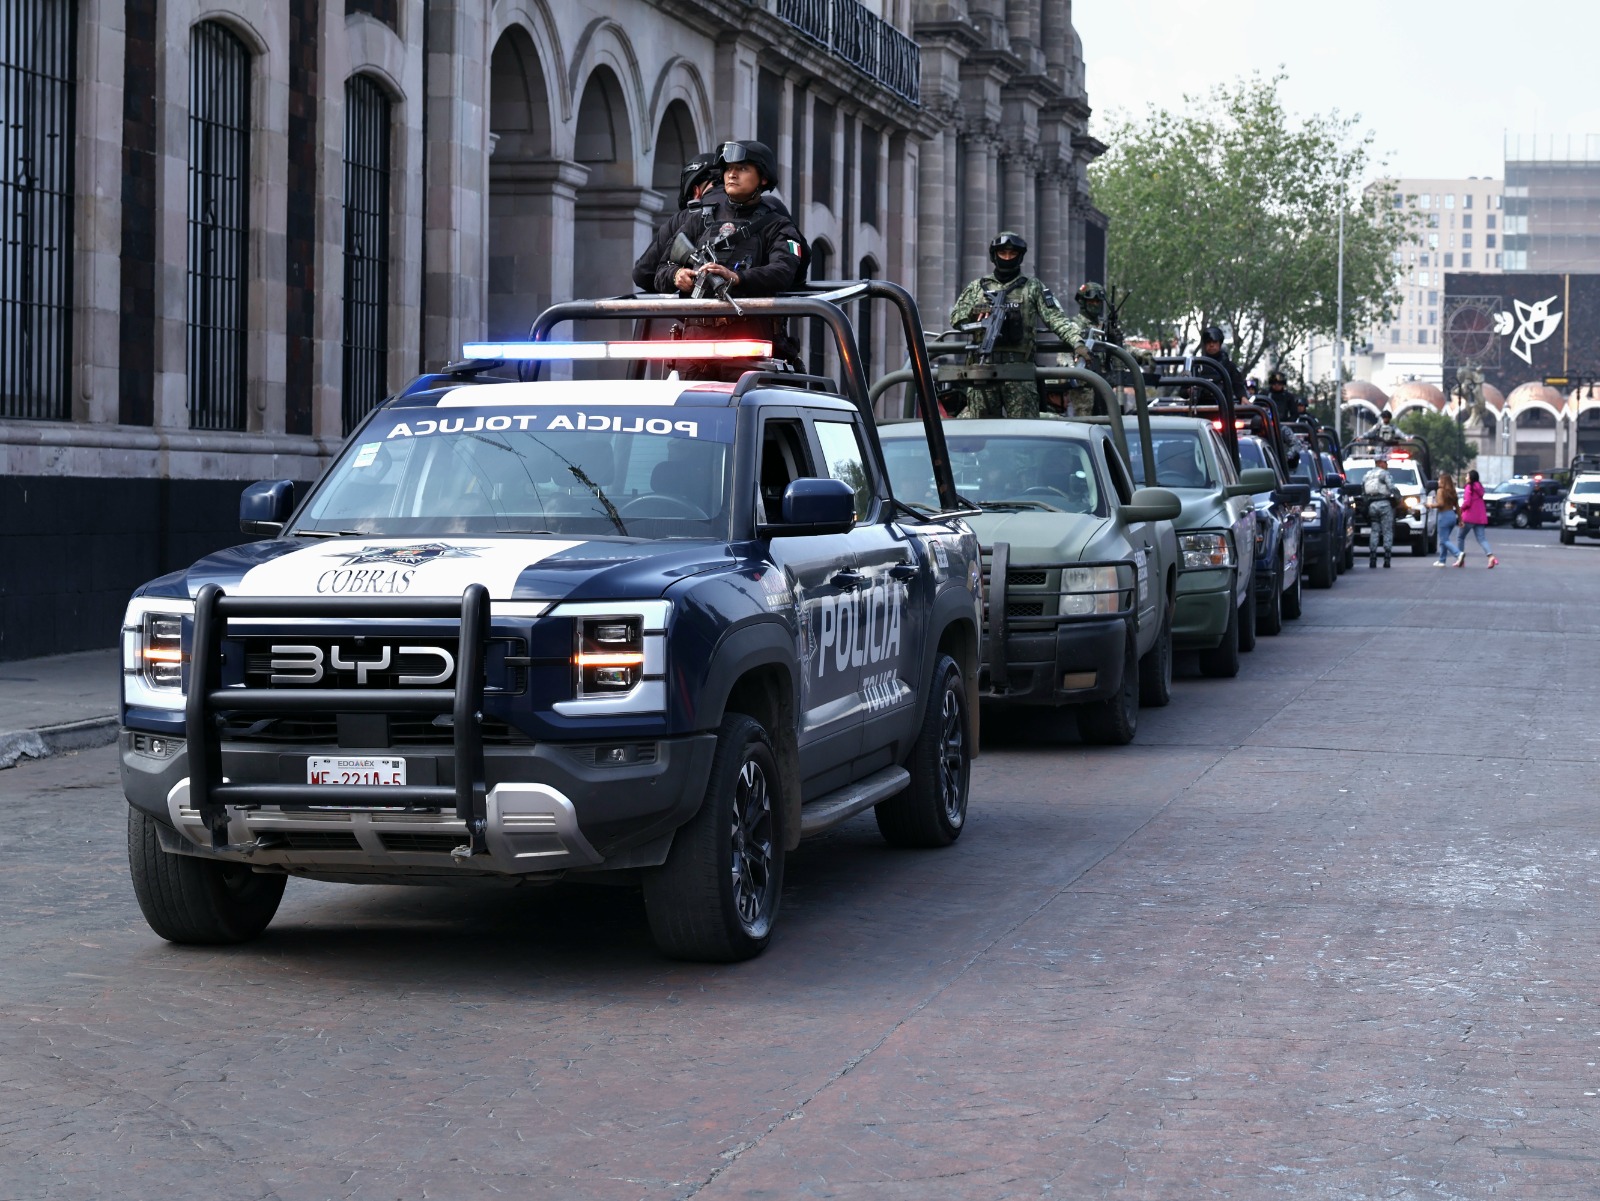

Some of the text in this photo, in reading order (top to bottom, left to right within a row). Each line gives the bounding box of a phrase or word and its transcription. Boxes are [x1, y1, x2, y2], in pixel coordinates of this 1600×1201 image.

[316, 569, 417, 594] COBRAS
[270, 645, 455, 685] BYD
[862, 668, 902, 713] TOLUCA
